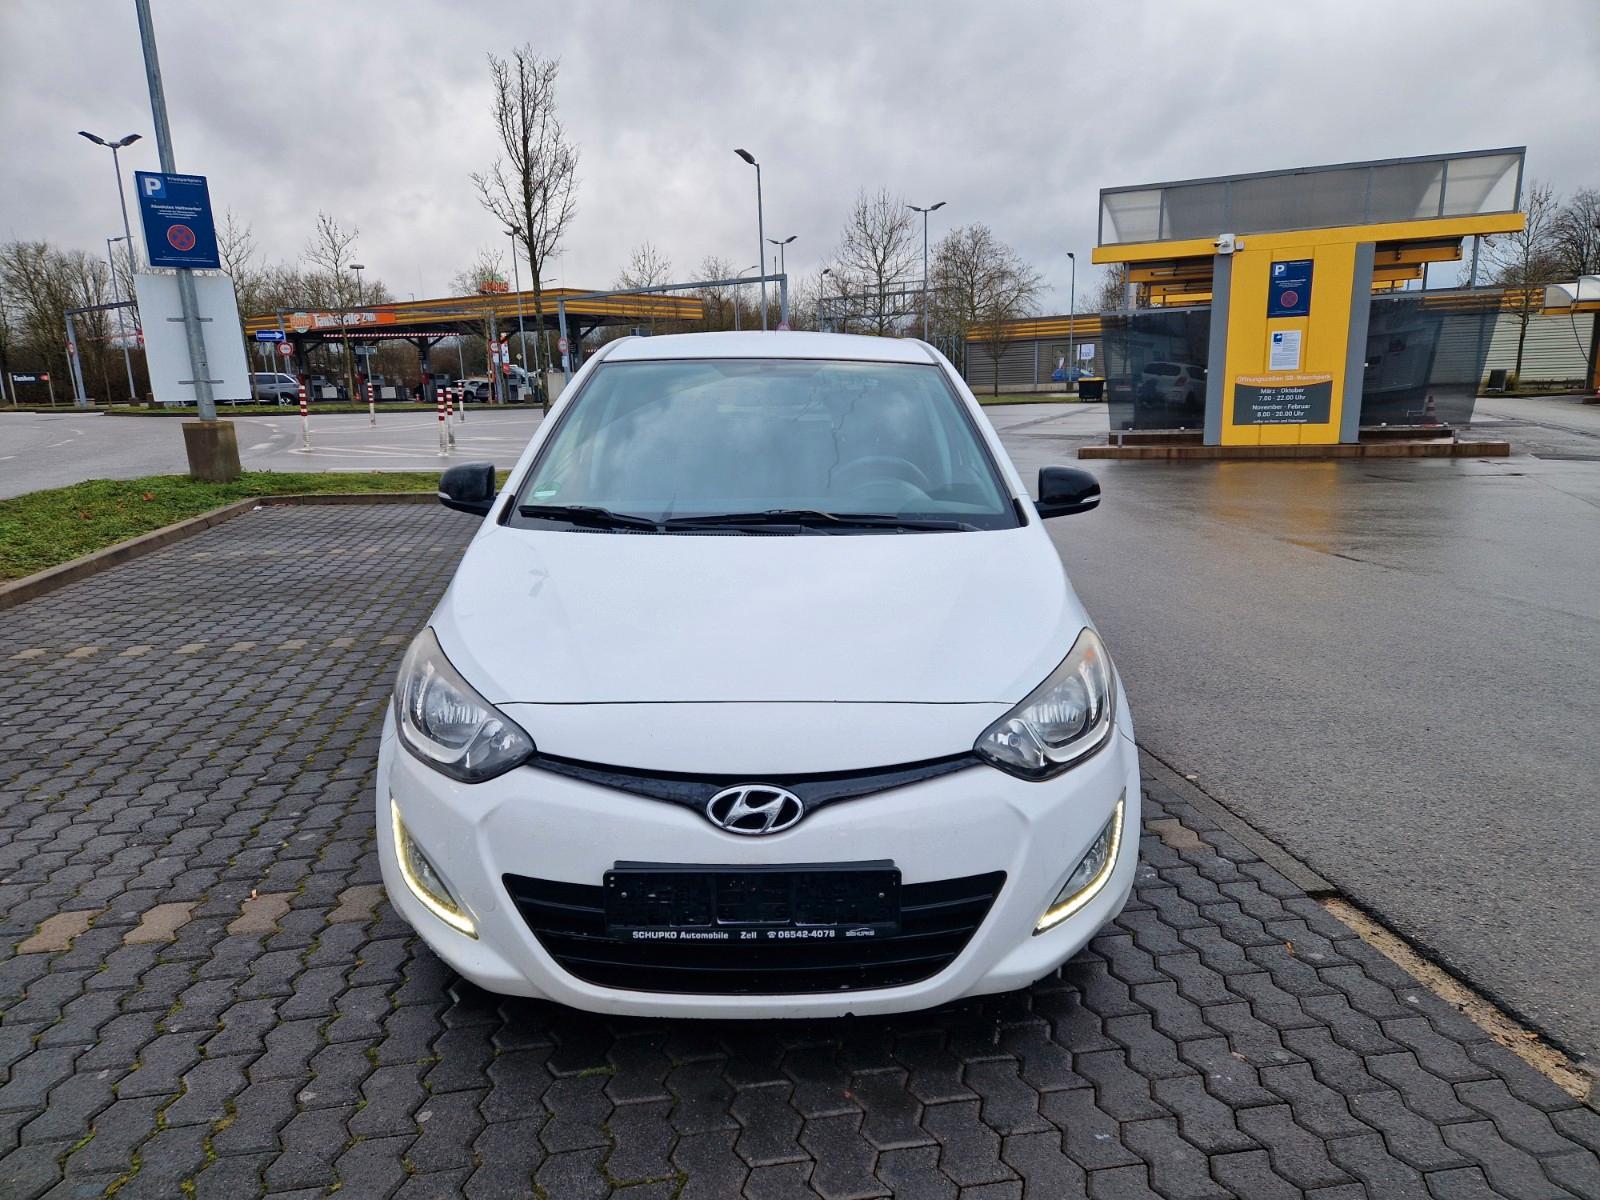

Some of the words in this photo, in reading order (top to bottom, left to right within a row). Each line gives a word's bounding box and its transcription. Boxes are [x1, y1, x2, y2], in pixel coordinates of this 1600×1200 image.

[144, 177, 161, 195] P
[1274, 264, 1285, 275] P
[632, 931, 678, 939] SCHUPKO
[680, 931, 729, 940] Automobile
[740, 931, 757, 939] Zell
[778, 929, 836, 939] 06542-4078
